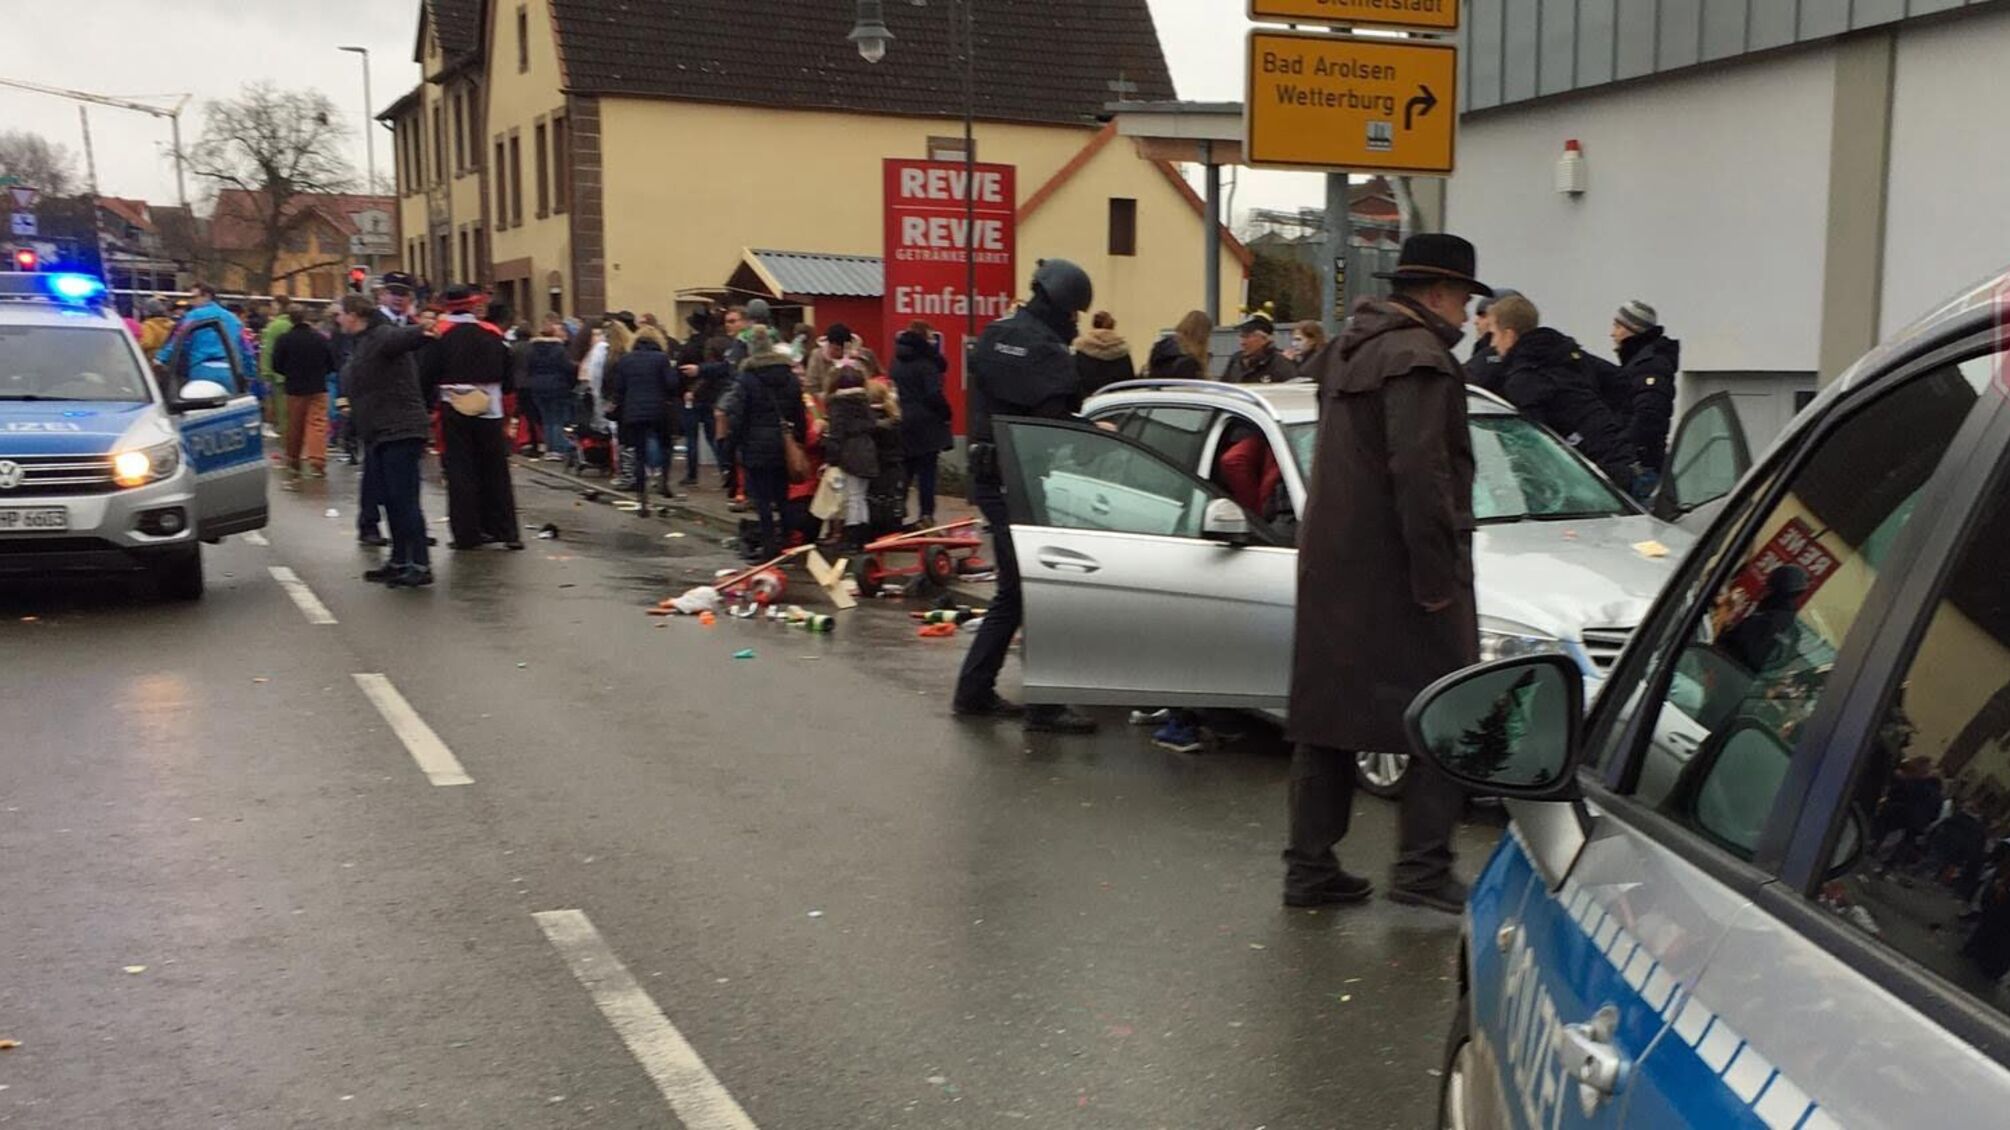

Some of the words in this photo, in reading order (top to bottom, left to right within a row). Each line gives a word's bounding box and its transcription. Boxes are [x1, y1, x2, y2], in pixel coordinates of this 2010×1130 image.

[1317, 0, 1441, 12] mestadt
[1263, 52, 1303, 76] Bad
[1314, 56, 1396, 81] Arolsen
[1276, 84, 1395, 116] Wetterburg
[900, 167, 1003, 202] REWE
[901, 215, 1004, 250] REWE
[895, 285, 1010, 316] Einfahrt
[191, 429, 246, 456] POLIZEI
